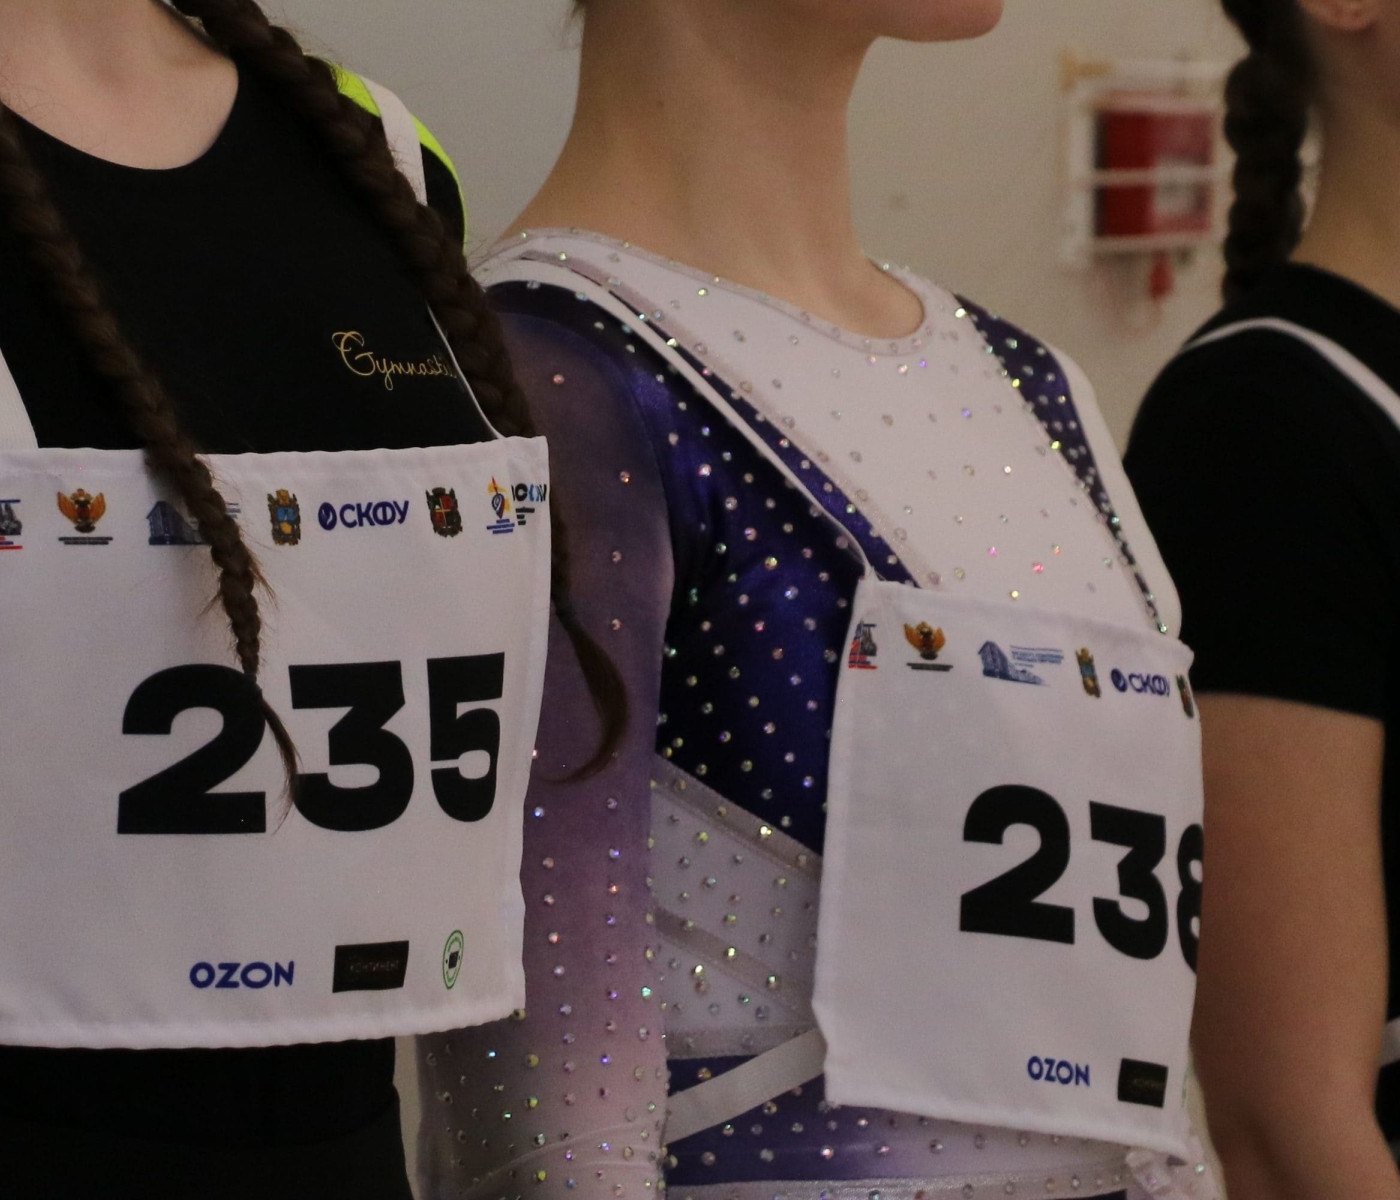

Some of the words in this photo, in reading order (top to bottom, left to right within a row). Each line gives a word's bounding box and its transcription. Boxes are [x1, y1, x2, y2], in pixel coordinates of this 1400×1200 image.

[331, 330, 458, 391] Gymnasti
[339, 500, 409, 528] СКФУ
[117, 652, 505, 835] 235
[959, 784, 1204, 975] 238
[189, 960, 294, 989] OZON
[1027, 1055, 1090, 1087] OZON
